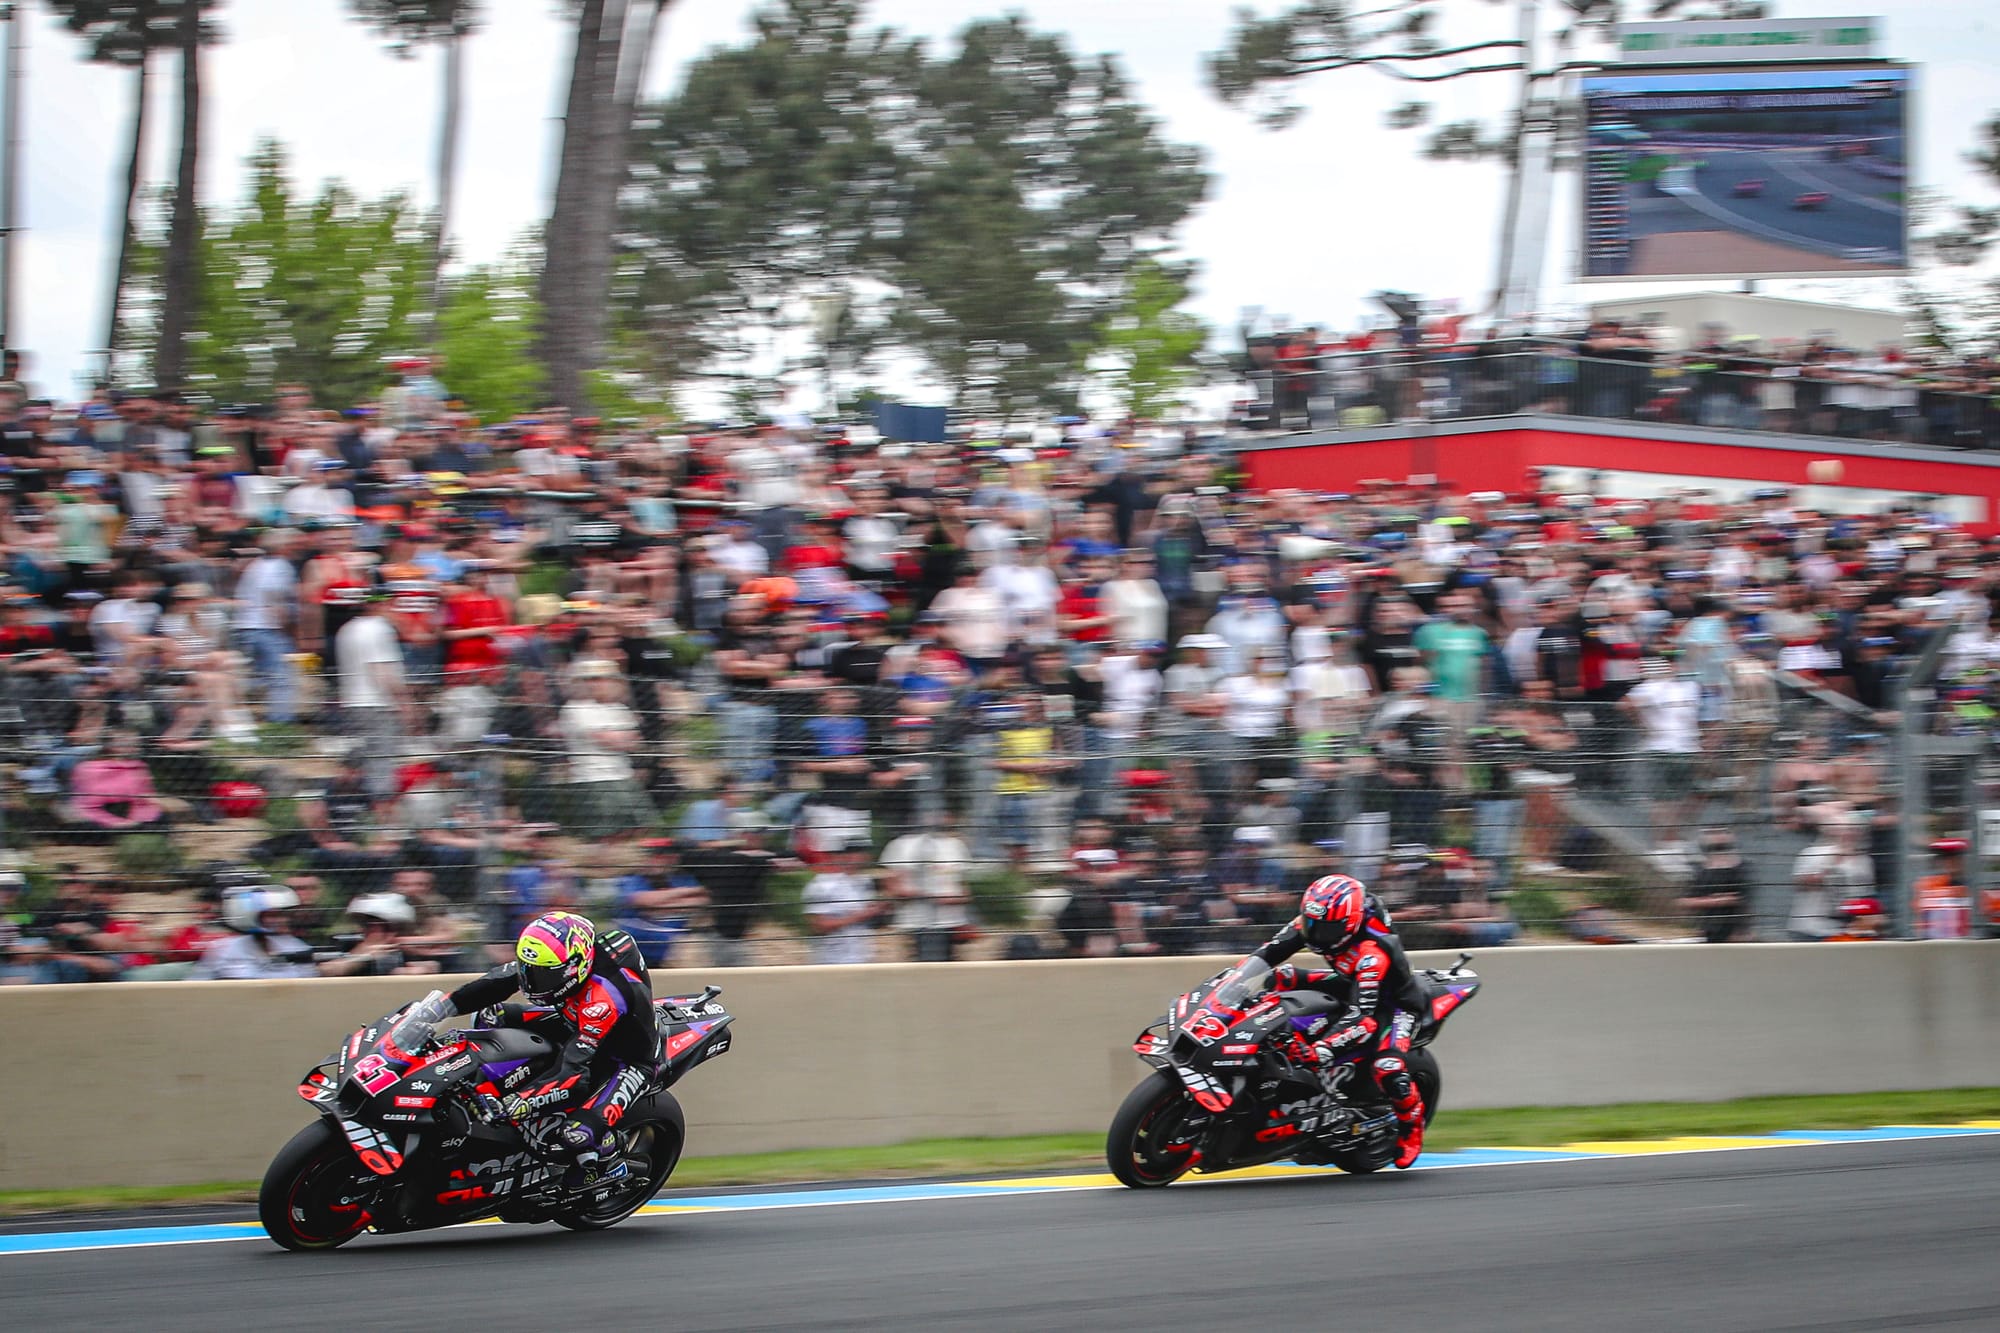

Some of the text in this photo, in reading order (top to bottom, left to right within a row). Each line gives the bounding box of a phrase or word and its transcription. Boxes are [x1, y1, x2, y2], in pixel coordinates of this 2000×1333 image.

[411, 1080, 432, 1093] sky
[504, 1065, 531, 1089] aprilia
[527, 1088, 570, 1109] aprilia
[603, 1065, 645, 1126] aprili
[441, 1136, 467, 1148] sky
